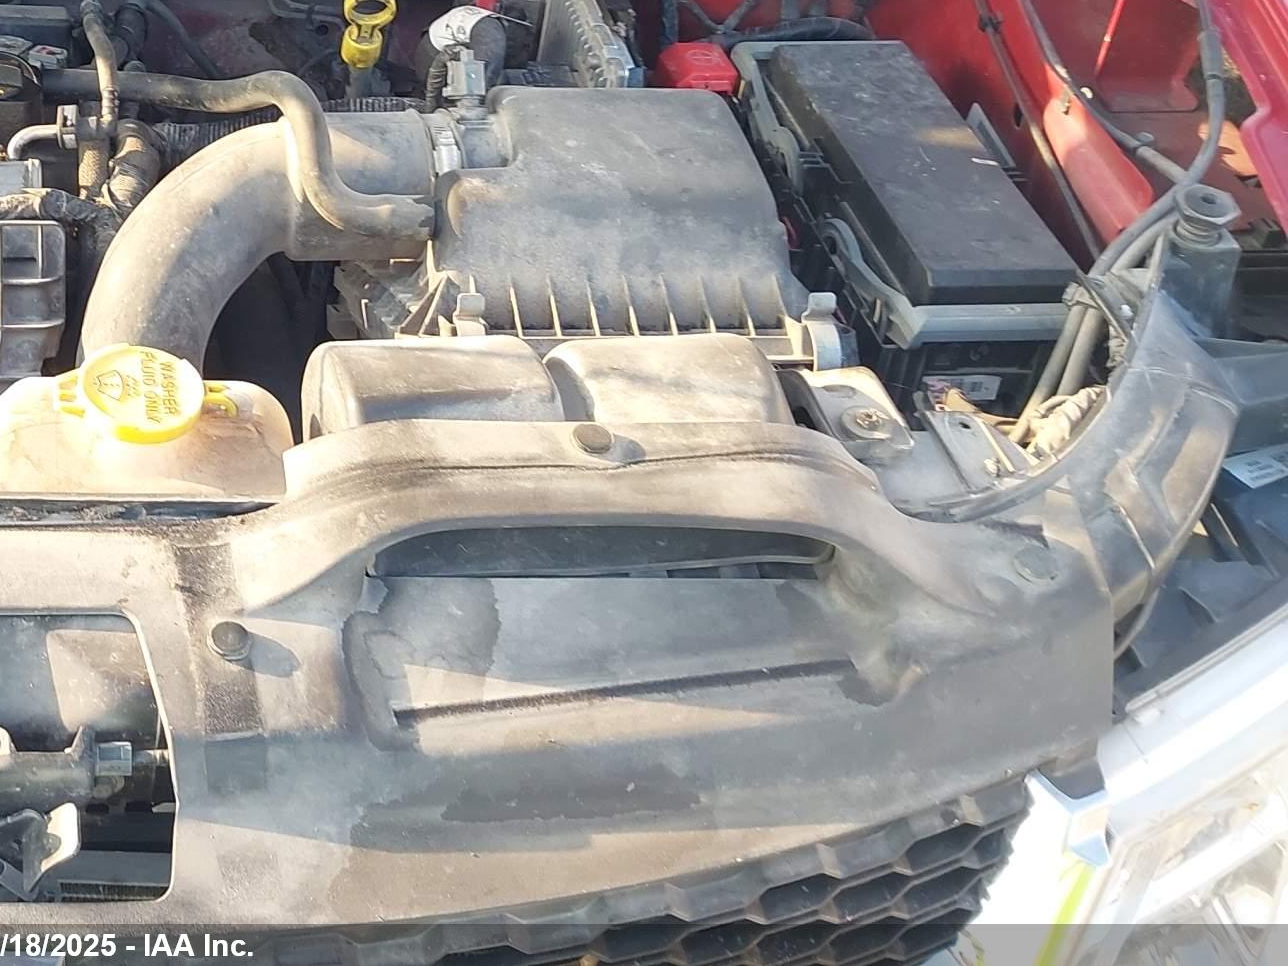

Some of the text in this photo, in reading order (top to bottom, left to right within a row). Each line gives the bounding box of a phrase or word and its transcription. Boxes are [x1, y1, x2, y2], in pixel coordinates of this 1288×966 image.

[140, 351, 162, 424] FLUID ONLY
[159, 361, 180, 416] WASHER
